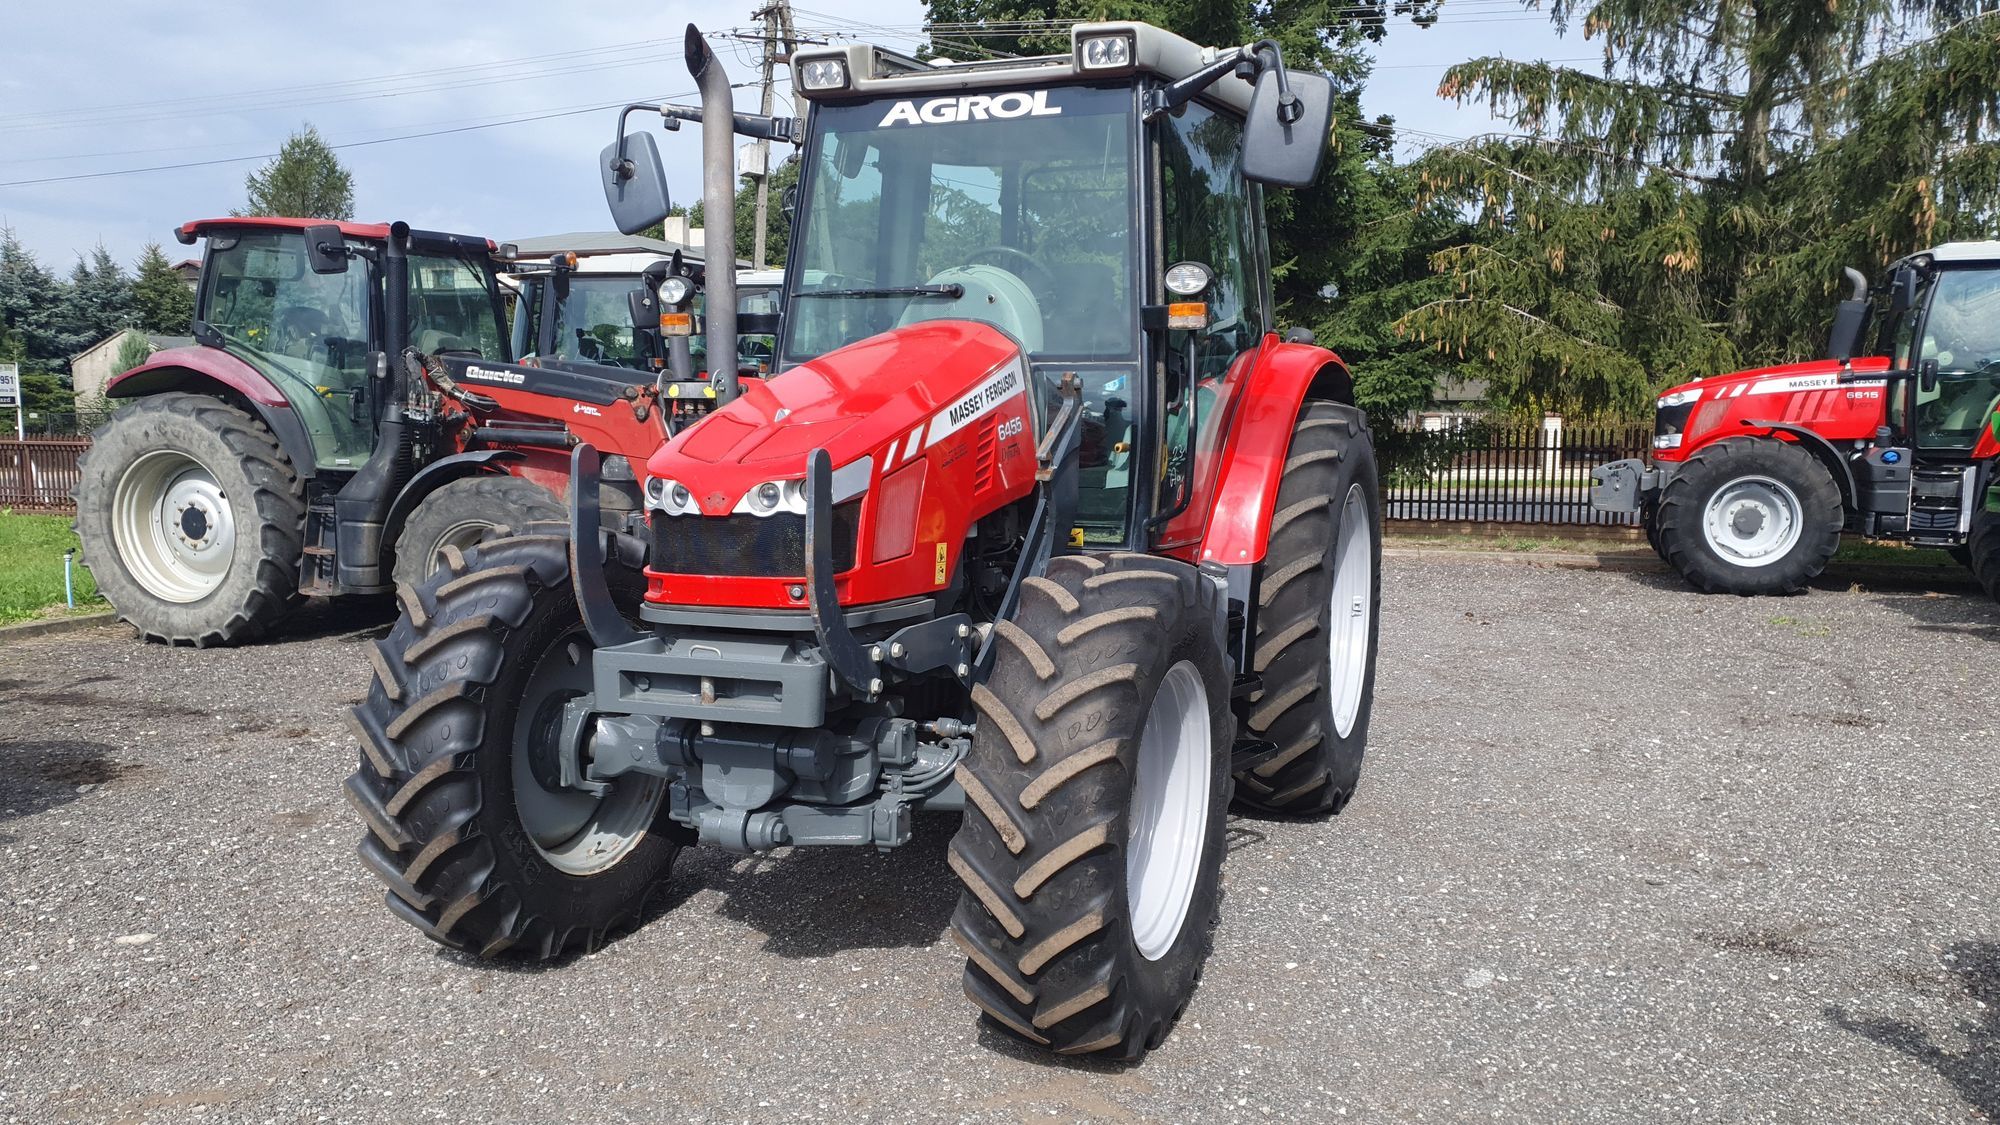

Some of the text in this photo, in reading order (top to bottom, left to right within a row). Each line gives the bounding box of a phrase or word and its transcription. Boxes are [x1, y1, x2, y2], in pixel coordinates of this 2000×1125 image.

[878, 90, 1062, 127] AGROL
[466, 365, 525, 384] Quicke
[1789, 379, 1827, 388] MASSEY
[949, 371, 1018, 426] MASSEY FERGUSON
[1846, 391, 1879, 399] 6615
[998, 416, 1022, 441] 6455
